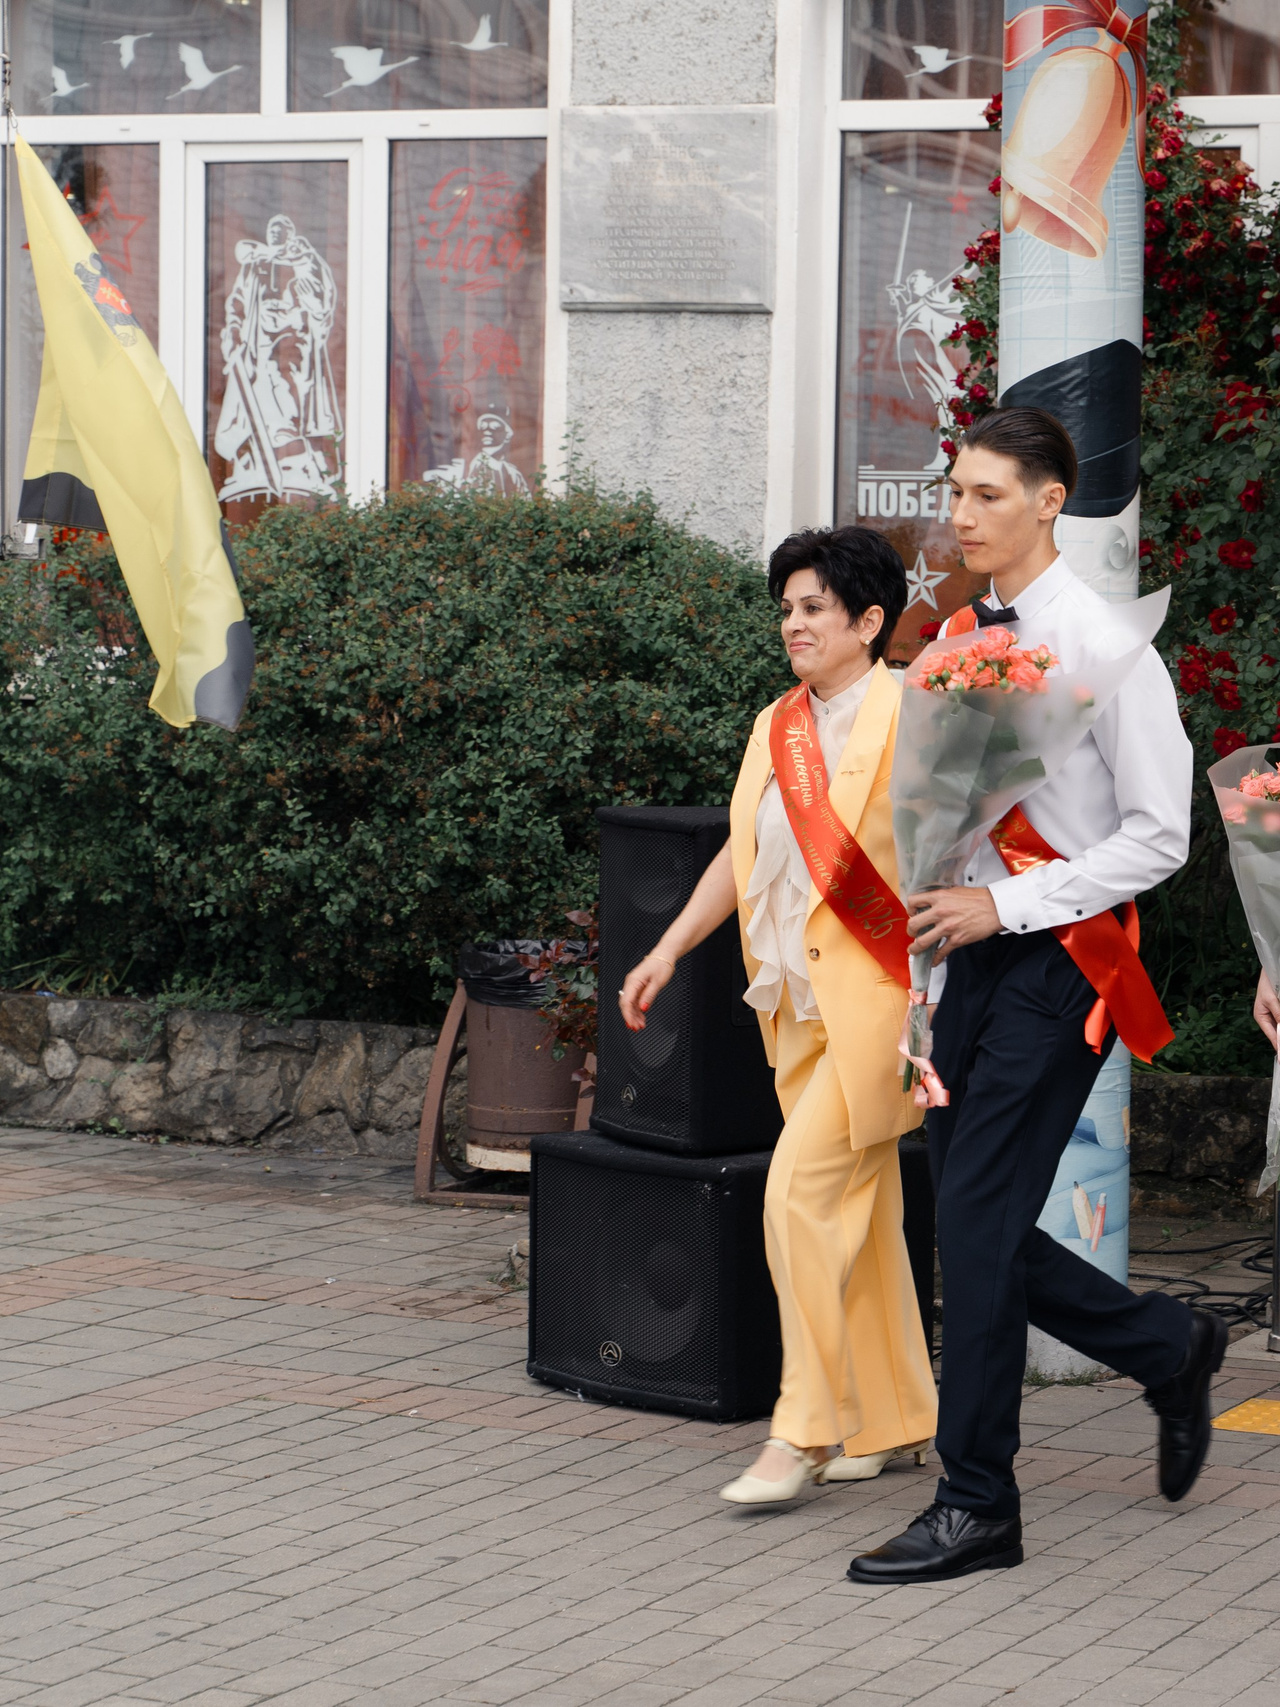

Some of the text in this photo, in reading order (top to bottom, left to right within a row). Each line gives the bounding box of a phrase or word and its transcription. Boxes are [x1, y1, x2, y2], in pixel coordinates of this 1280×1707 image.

[428, 167, 477, 238] 9
[425, 231, 526, 275] мая
[857, 481, 953, 524] ПОБЕД
[784, 705, 814, 809] Классный
[847, 885, 906, 940] 2026
